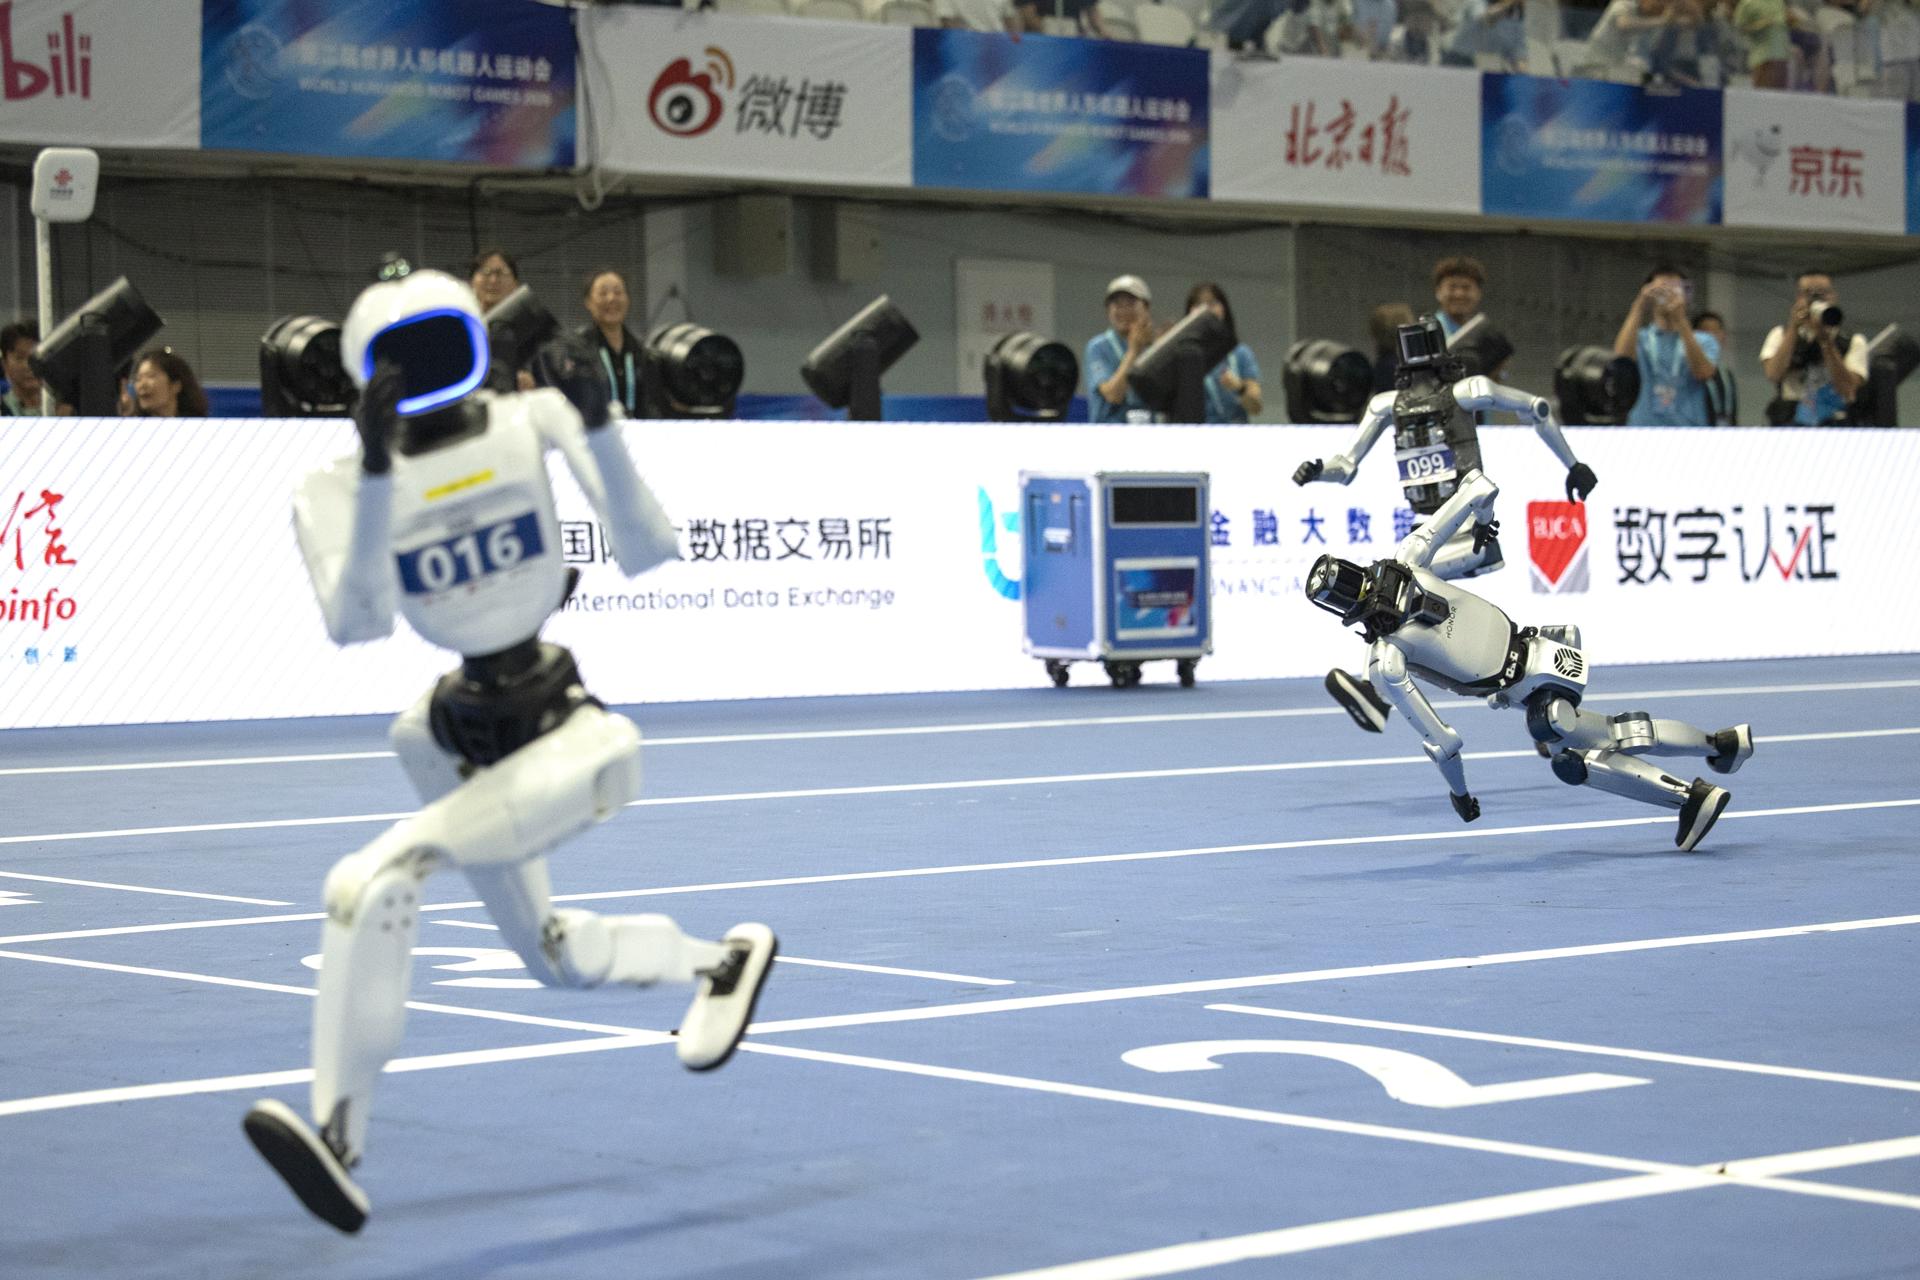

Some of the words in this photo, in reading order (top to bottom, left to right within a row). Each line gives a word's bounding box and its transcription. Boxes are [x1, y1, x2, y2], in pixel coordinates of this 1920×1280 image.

[0, 0, 92, 101] bili
[736, 74, 848, 140] 微博
[1788, 144, 1866, 198] 京东
[1407, 453, 1446, 479] 099
[560, 517, 894, 562] 国数据交易所
[1533, 515, 1584, 540] BJCA
[1613, 505, 1840, 585] 数字认证
[417, 522, 525, 592] 016
[564, 587, 715, 613] nternational
[723, 587, 781, 609] Data
[788, 586, 896, 609] Exchange
[1446, 606, 1458, 640] HONOR
[1119, 1038, 1656, 1110] 2
